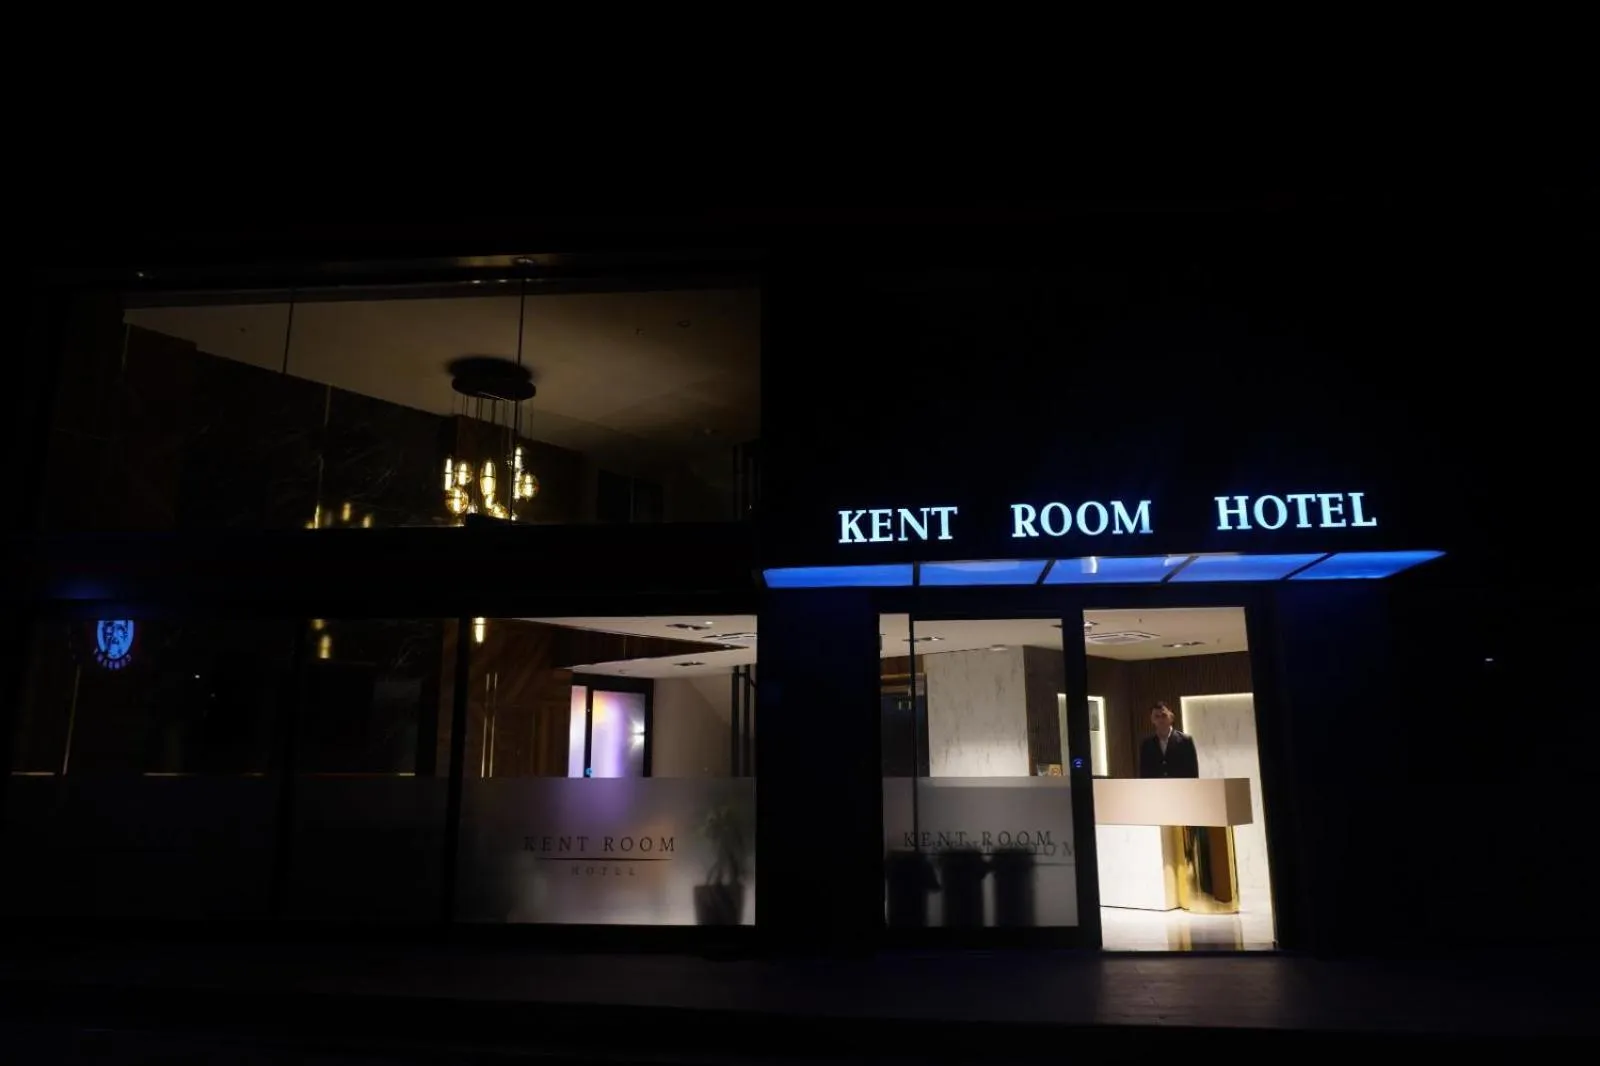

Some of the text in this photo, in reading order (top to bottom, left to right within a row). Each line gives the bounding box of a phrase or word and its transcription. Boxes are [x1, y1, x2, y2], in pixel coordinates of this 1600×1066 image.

[837, 491, 1378, 544] KENT ROOM HOTEL
[523, 836, 675, 852] KENT ROOM
[903, 831, 968, 848] KENT
[982, 830, 1054, 847] ROOM
[571, 866, 636, 877] HOTEL
